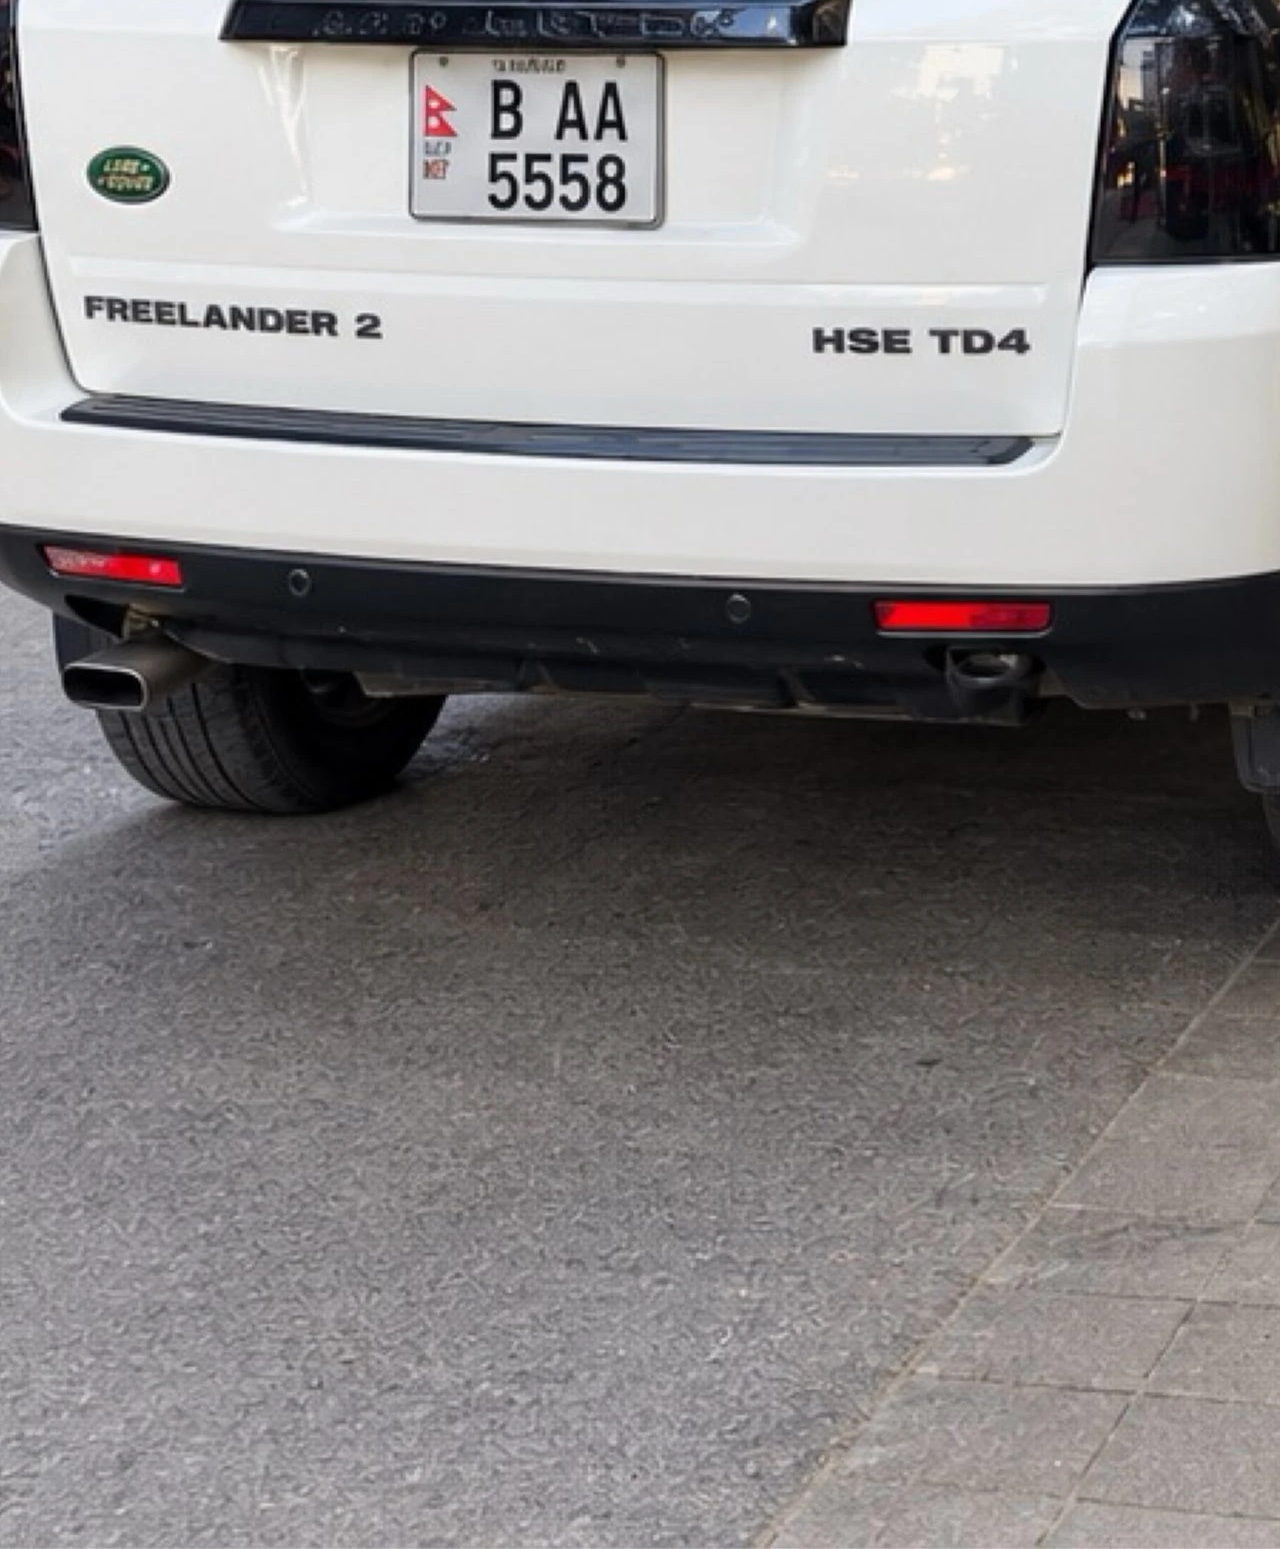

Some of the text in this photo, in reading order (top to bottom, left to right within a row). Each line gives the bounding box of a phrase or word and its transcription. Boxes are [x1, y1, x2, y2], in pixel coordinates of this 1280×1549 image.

[490, 78, 629, 142] B AA
[487, 152, 627, 212] 5558
[83, 294, 383, 340] FREELANDER 2
[812, 328, 1031, 355] HSE TD4
